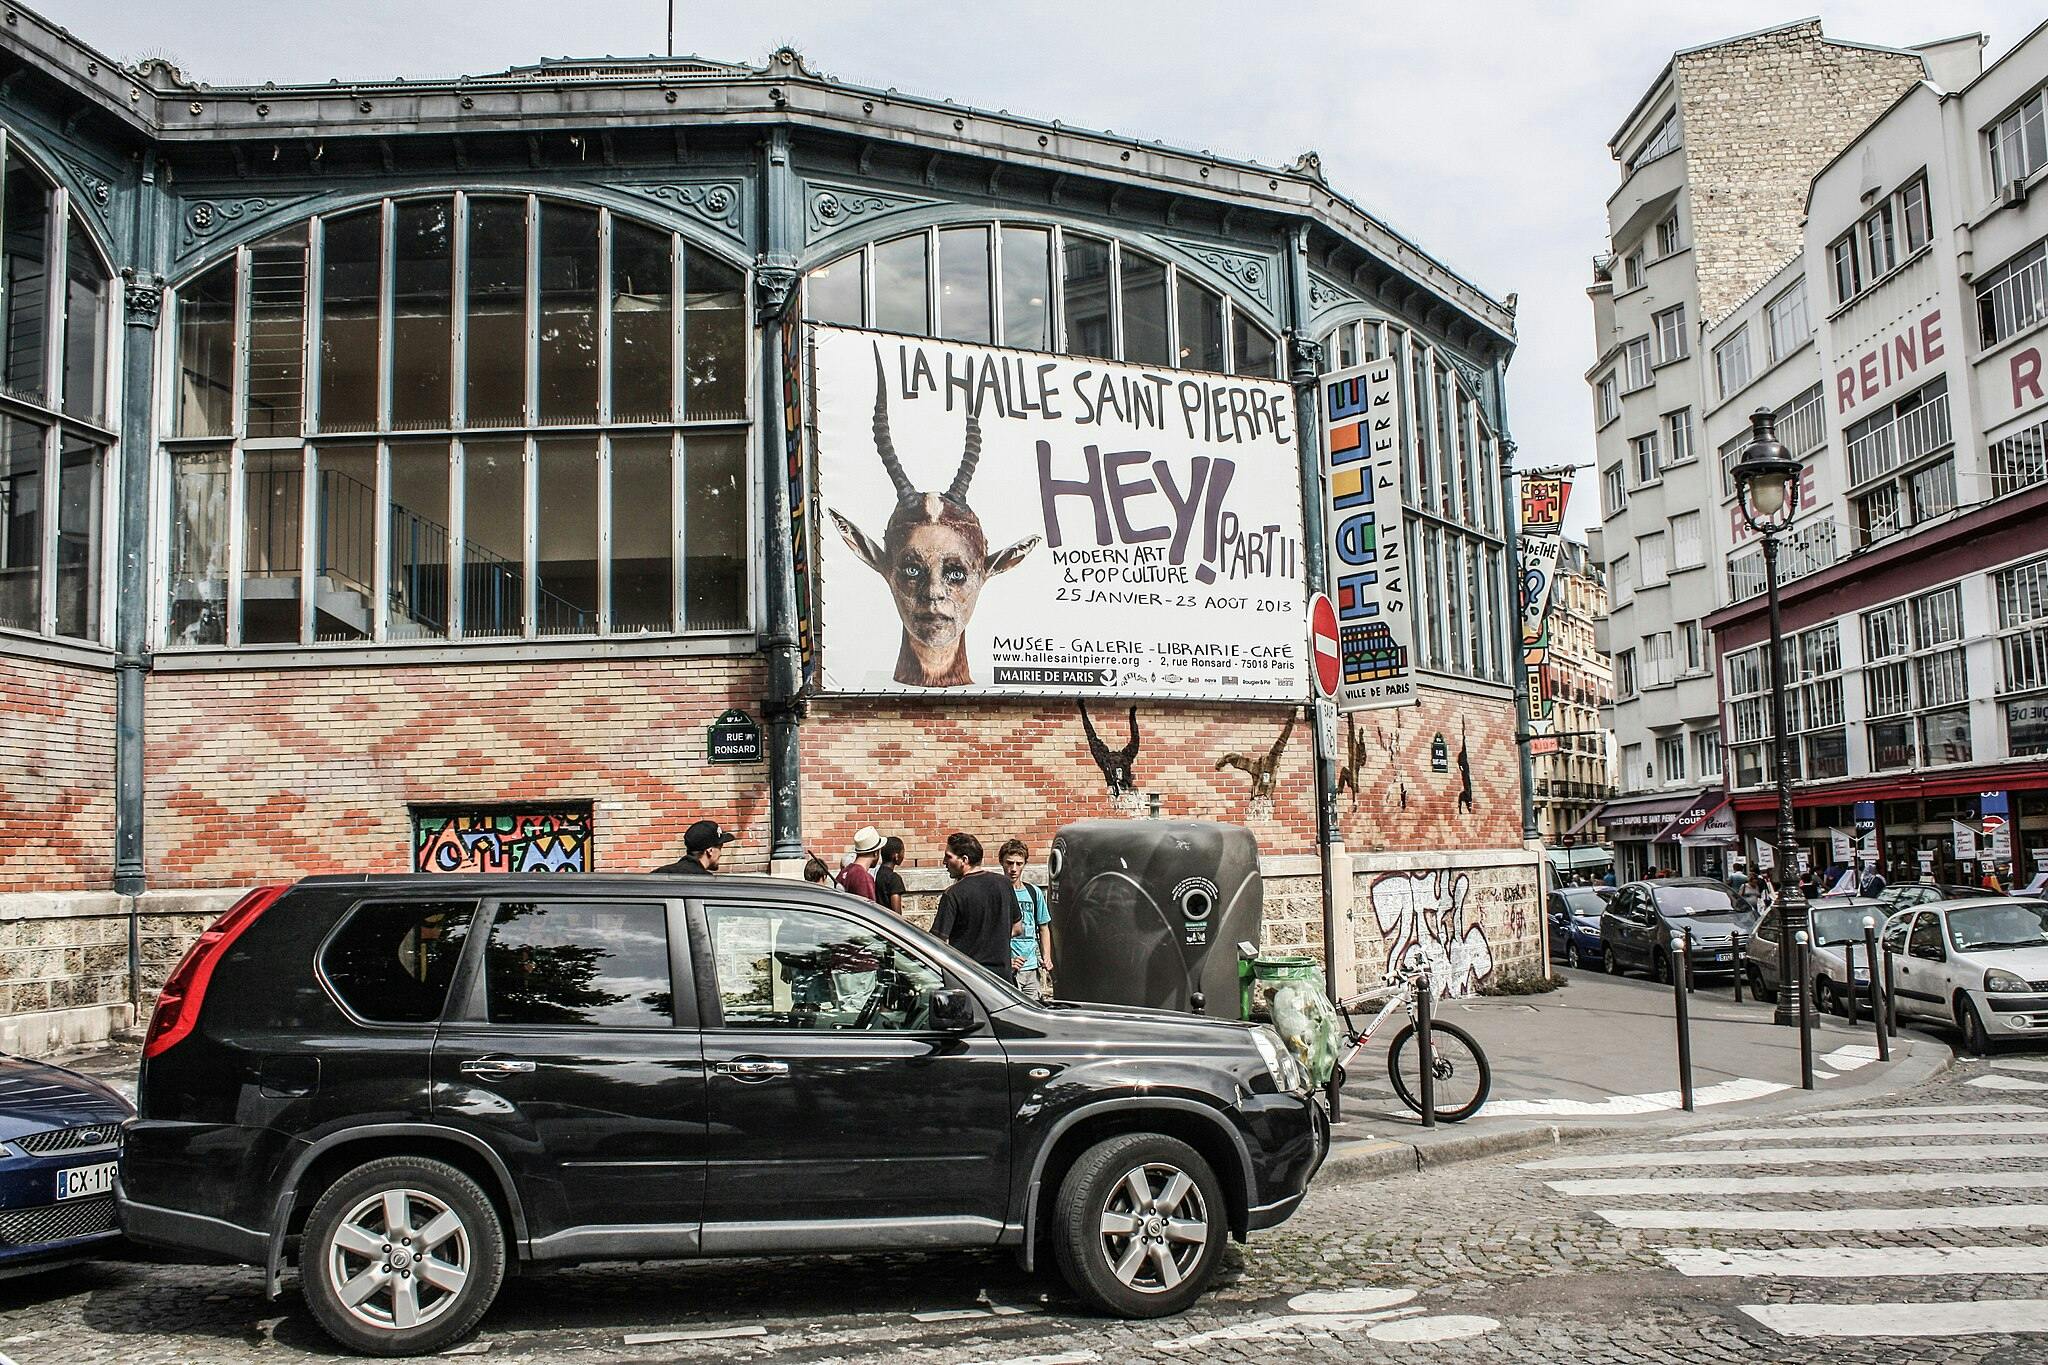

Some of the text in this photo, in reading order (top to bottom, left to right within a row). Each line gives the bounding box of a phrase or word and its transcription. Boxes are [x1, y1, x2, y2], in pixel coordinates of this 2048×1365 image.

[1836, 308, 1945, 415] REINE
[900, 345, 1292, 444] LA HALLE SAINT PIERRE
[1327, 374, 1380, 622] HALLE
[1372, 369, 1404, 613] SAINT PIERRE
[1036, 440, 1235, 585] HEY!
[1220, 511, 1279, 580] PART
[1053, 546, 1166, 565] MODERN ART
[1064, 566, 1189, 584] & POP CULTURE
[1056, 588, 1081, 601] 25
[1176, 596, 1196, 607] 23
[1257, 600, 1292, 612] 2013
[993, 636, 1054, 651] MUSÉE
[1071, 638, 1144, 654] GALERIE
[993, 652, 1140, 667] www.hallesaintpierre.org
[1160, 657, 1169, 668] 2,
[1172, 659, 1188, 667] rue
[1191, 658, 1231, 668] Ronsard
[1241, 659, 1268, 669] 75018
[1271, 660, 1295, 670] Paris
[999, 669, 1094, 683] MAIRIE DE PARIS
[1345, 683, 1410, 699] VILLE DE PARIS
[726, 732, 744, 741] RUE
[714, 745, 756, 754] RONSARD
[1691, 808, 1706, 816] LES
[1704, 816, 1728, 832] Reine
